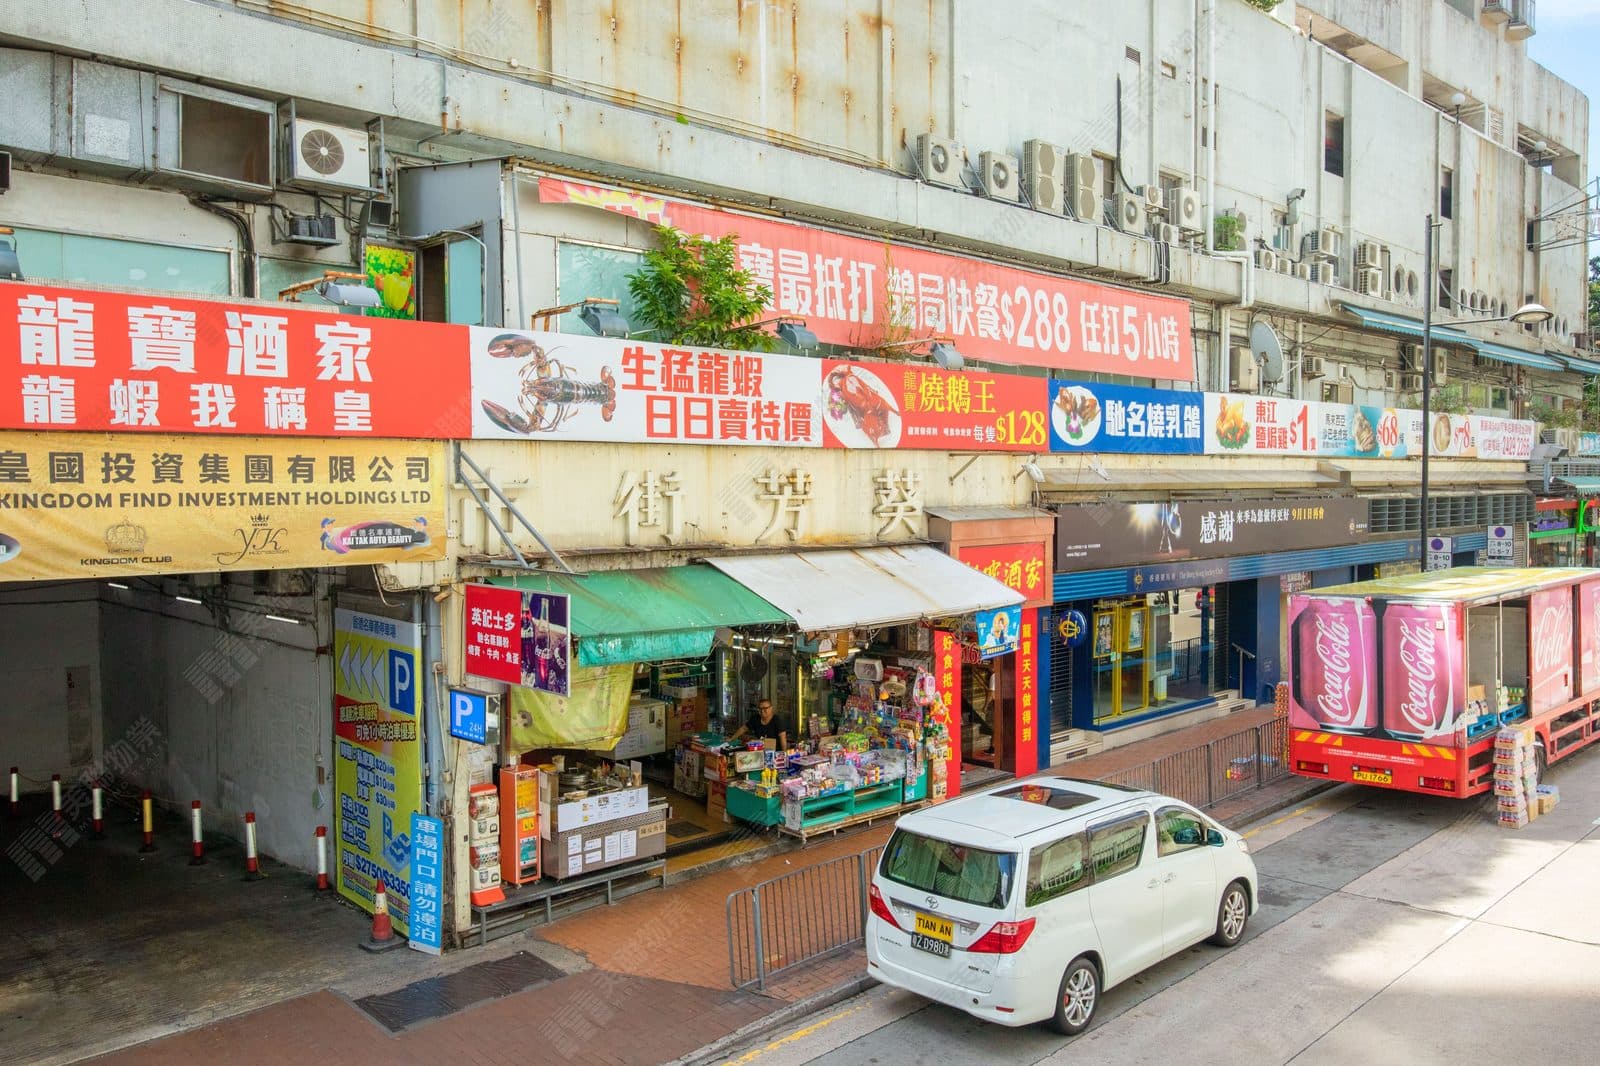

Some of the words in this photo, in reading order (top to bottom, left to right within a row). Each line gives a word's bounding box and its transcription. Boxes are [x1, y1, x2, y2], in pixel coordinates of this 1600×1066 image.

[17, 294, 372, 383] 龍寶酒家
[1080, 302, 1180, 363] 任打5小時
[621, 347, 763, 398] 生猛龍蝦
[21, 374, 373, 432] 龍蝦我稱皇
[919, 371, 997, 415] 燒鵝王
[646, 395, 812, 442] 日日賣特價
[973, 425, 996, 443] 每隻
[996, 410, 1046, 446] $128
[1105, 398, 1201, 440] 馳名燒乳鴿
[1256, 400, 1277, 423] 東江
[1256, 426, 1288, 449] 鹽焗雞
[1377, 415, 1398, 446] $68
[0, 449, 432, 486] 皇國投資集團有限公司
[0, 493, 112, 509] KINGDOM
[119, 492, 172, 508] FIND
[178, 491, 301, 507] INVESTMENT
[306, 490, 397, 506] HOLDINGS
[402, 490, 431, 504] LTD
[343, 536, 354, 545] KAI
[356, 536, 368, 545] TAK
[369, 535, 386, 545] AUTO
[388, 534, 412, 544] BEAUTY
[1200, 510, 1235, 544] 感謝
[80, 557, 138, 566] KINGDOM
[472, 607, 516, 631] 英記士多
[395, 656, 410, 704] P
[1022, 624, 1032, 742] 龍寶天天做得到
[455, 694, 473, 726] P
[469, 722, 482, 734] 24H
[1356, 772, 1368, 780] PU
[1370, 773, 1389, 783] 1766
[917, 917, 937, 931] TIAN
[938, 925, 951, 938] AN
